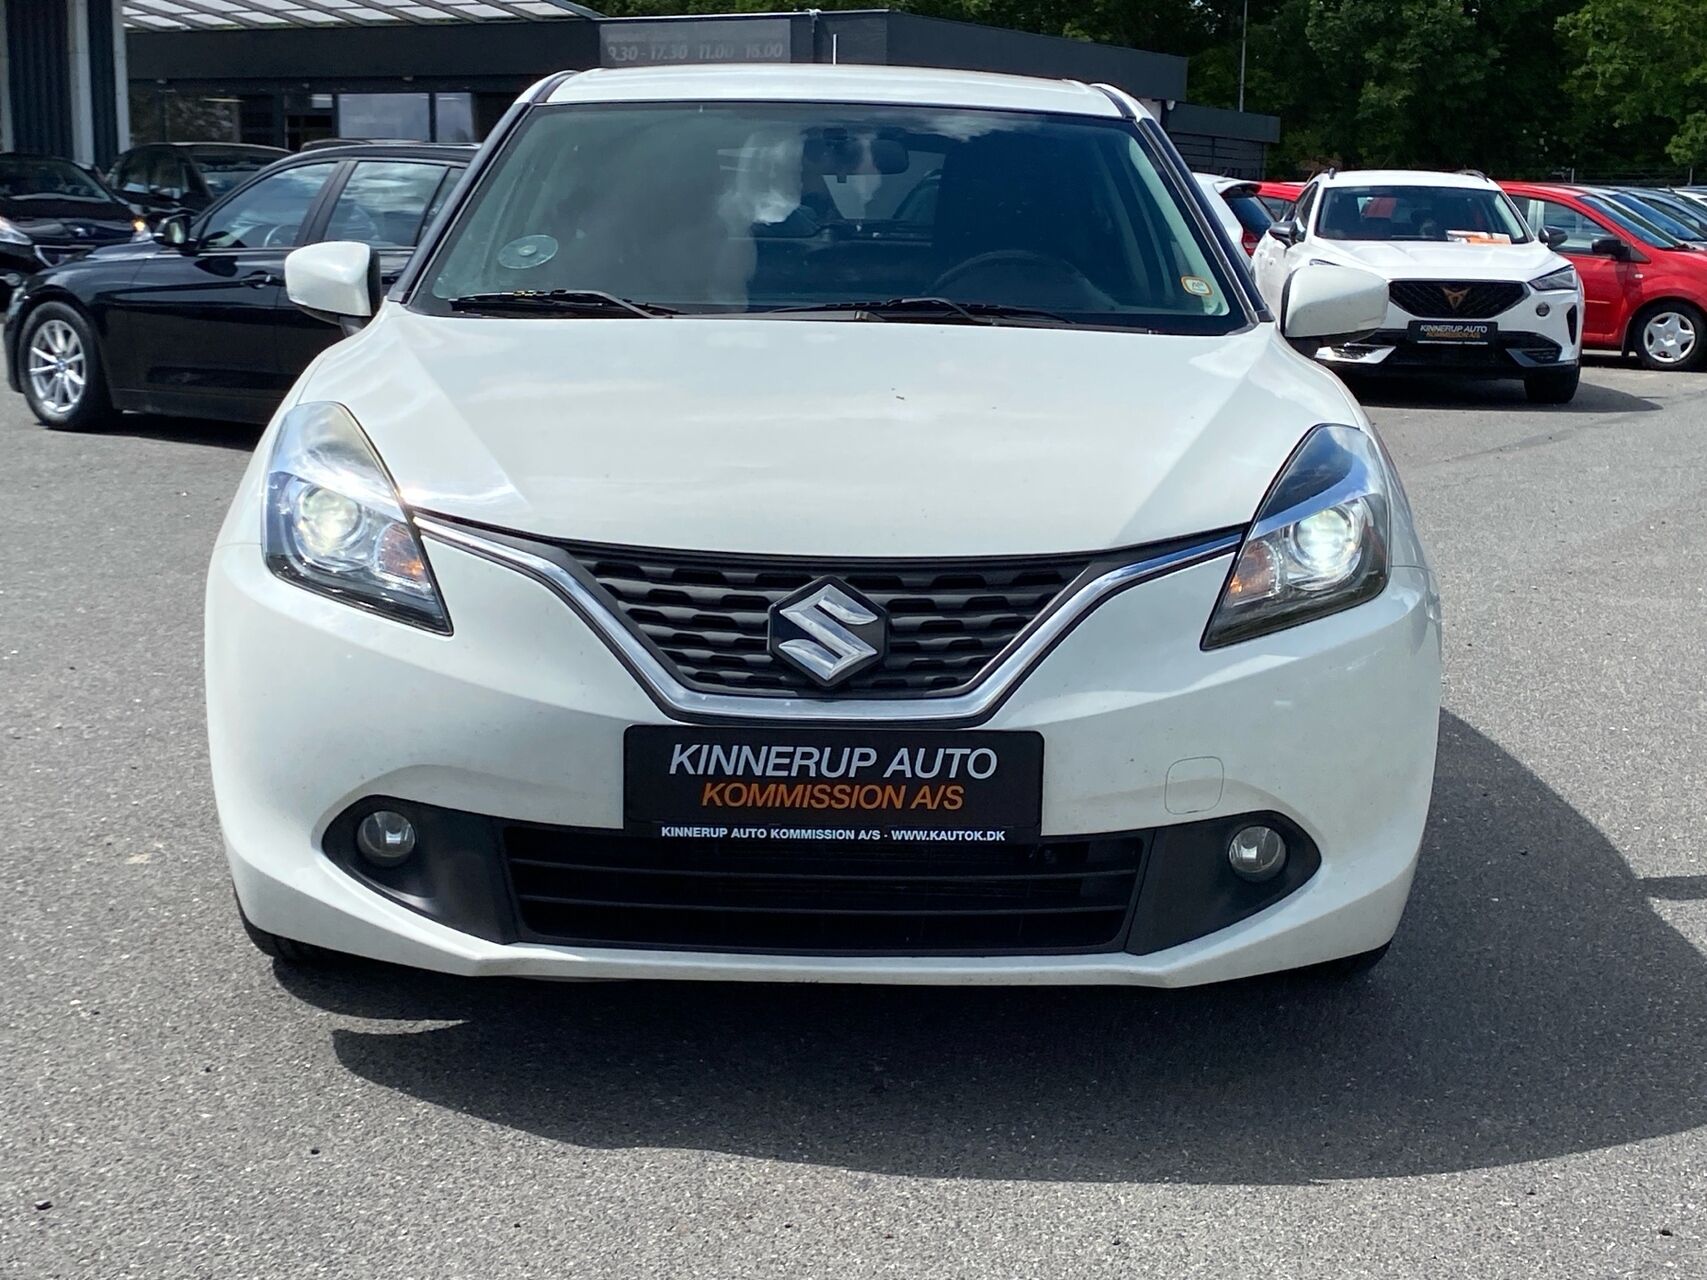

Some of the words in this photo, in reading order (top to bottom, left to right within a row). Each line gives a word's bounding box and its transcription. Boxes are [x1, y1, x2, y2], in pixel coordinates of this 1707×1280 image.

[1420, 324, 1463, 332] KINNERUP
[1464, 325, 1488, 333] AUTO
[669, 744, 878, 778] KINNERUP
[882, 747, 998, 780] AUTO
[702, 782, 907, 810] KOMMISSION
[910, 785, 965, 810] A/S
[661, 826, 728, 838] KINNERUP
[731, 827, 767, 839] AUTO
[770, 828, 855, 840] KOMMISSION
[858, 829, 881, 840] A/S
[891, 829, 1006, 842] WWW.KAUTOK.DK
